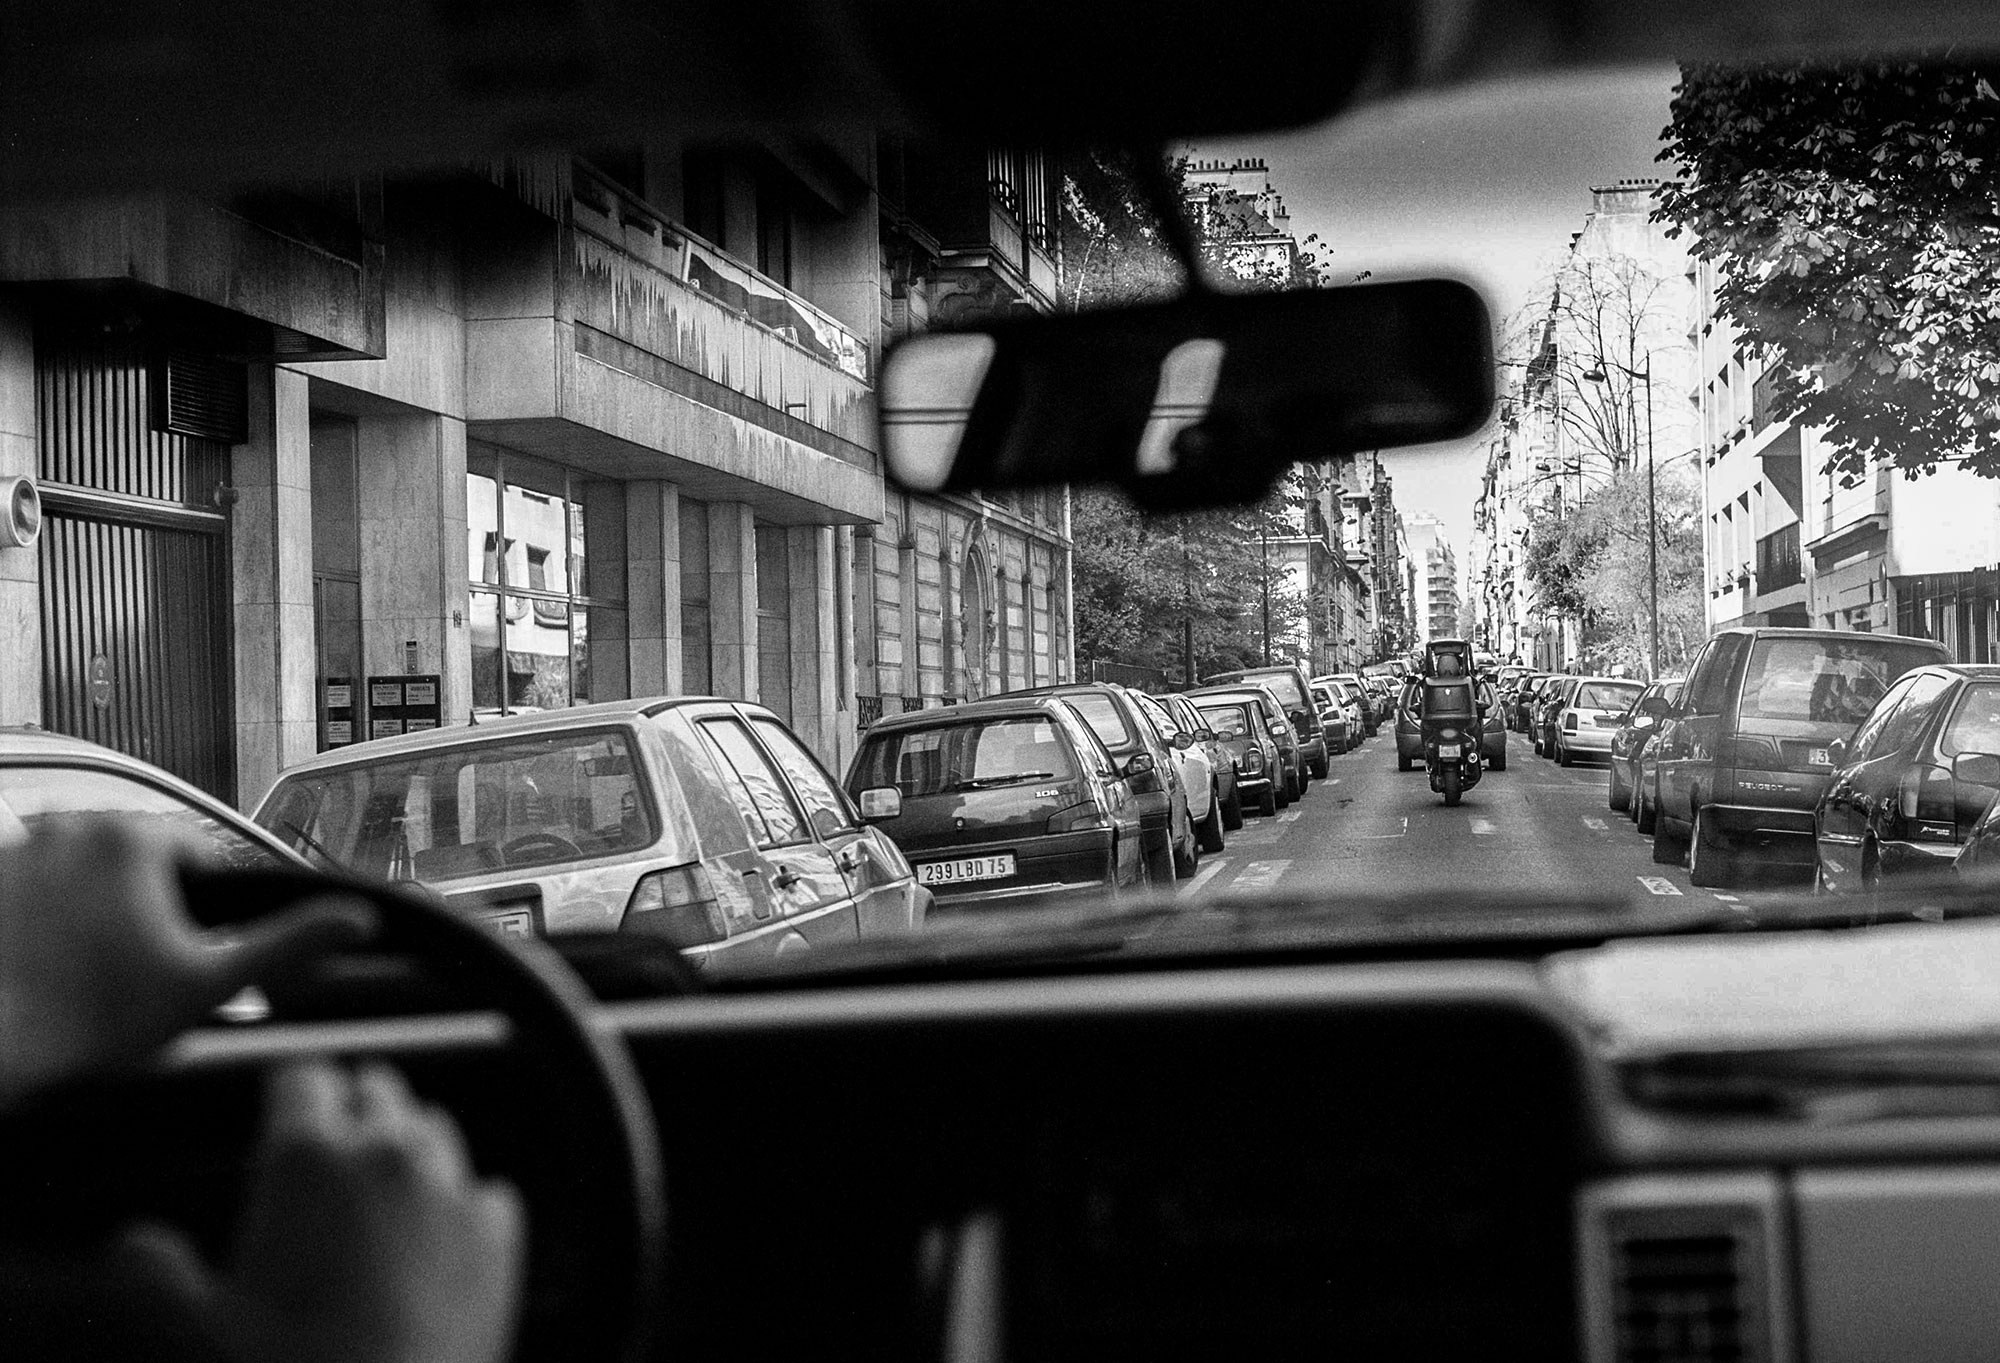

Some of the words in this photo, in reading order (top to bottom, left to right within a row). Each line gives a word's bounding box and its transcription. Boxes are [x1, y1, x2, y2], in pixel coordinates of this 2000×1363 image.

[926, 863, 952, 881] 299
[956, 860, 983, 878] LBD
[987, 857, 1006, 874] 75
